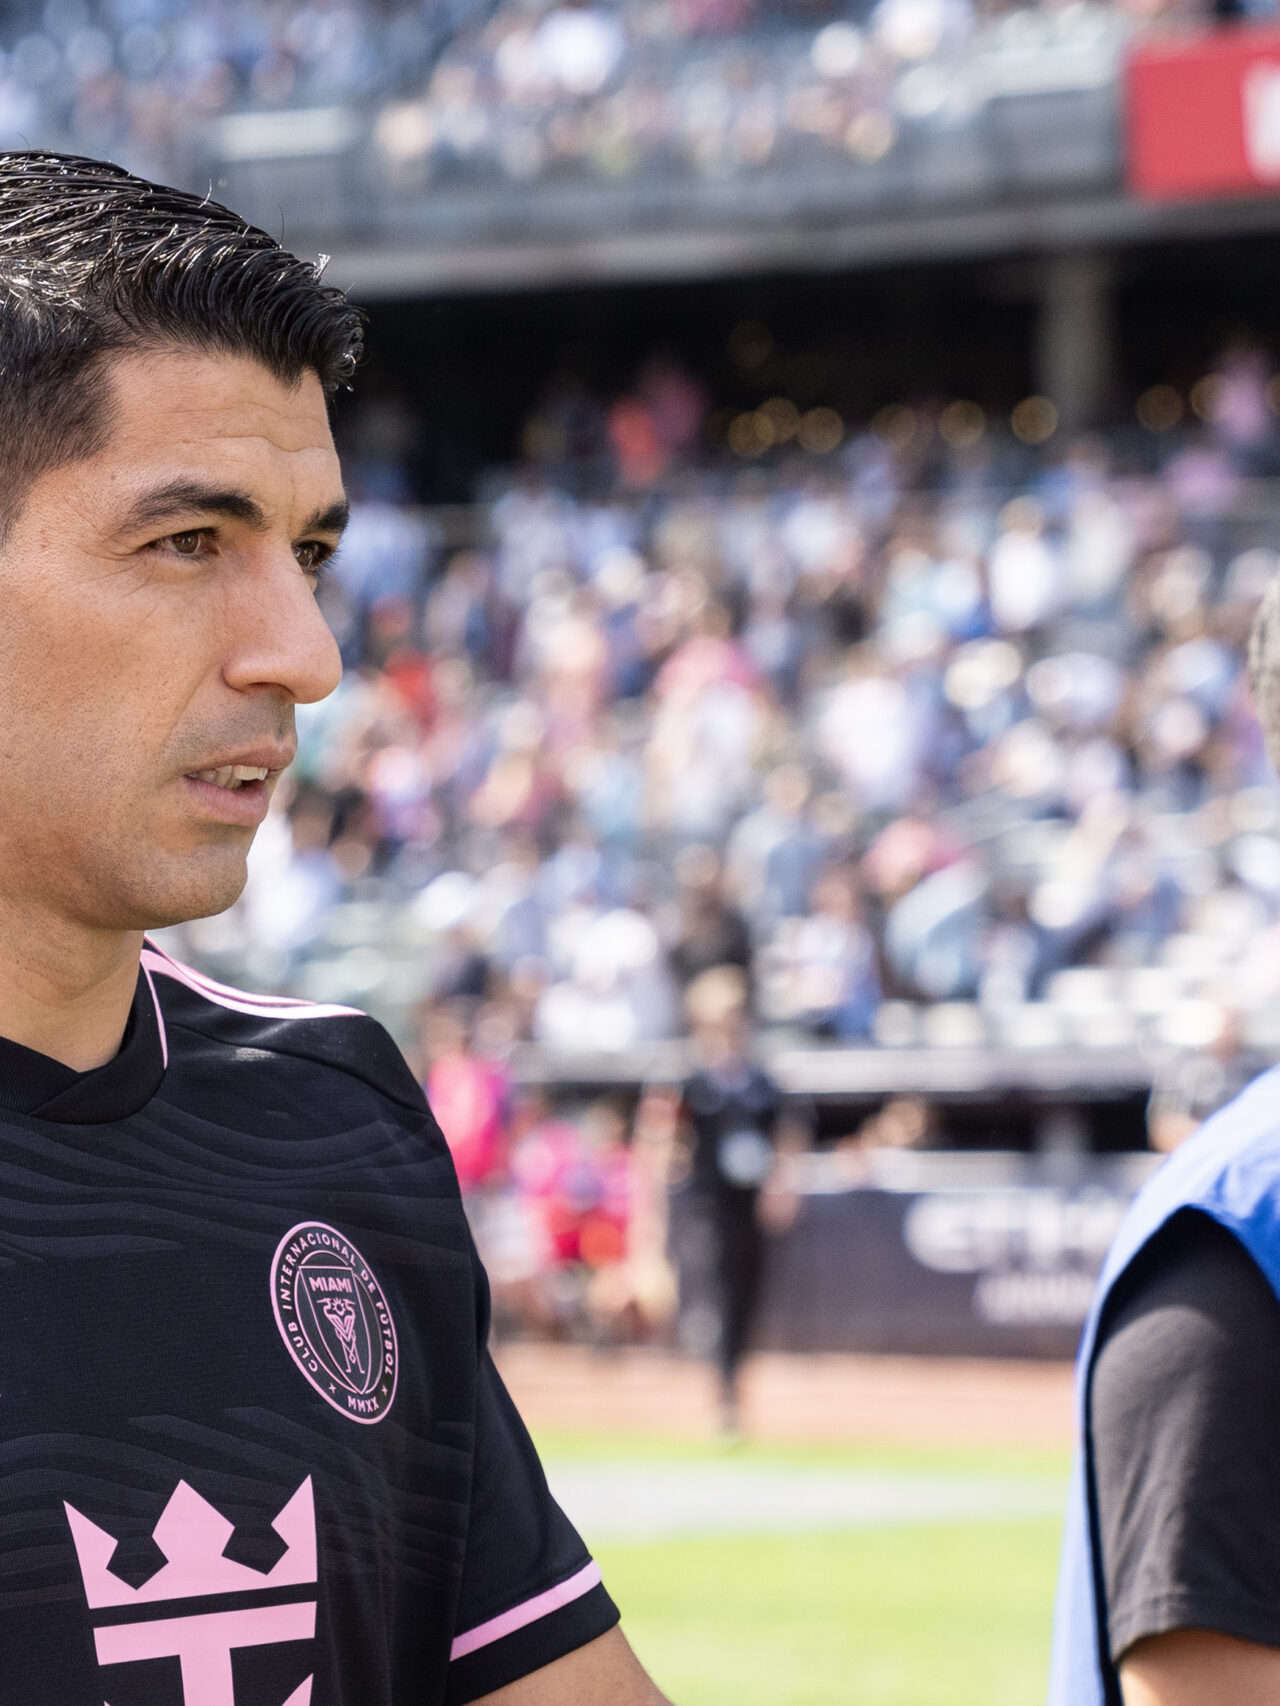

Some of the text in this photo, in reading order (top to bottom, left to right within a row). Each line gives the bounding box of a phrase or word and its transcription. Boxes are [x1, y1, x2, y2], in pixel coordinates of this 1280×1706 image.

[280, 1232, 357, 1310] INTERNACIONAL
[308, 1276, 353, 1293] MIAMI
[360, 1268, 375, 1295] DE
[287, 1321, 318, 1373] CLUB
[347, 1394, 380, 1413] MMXX
